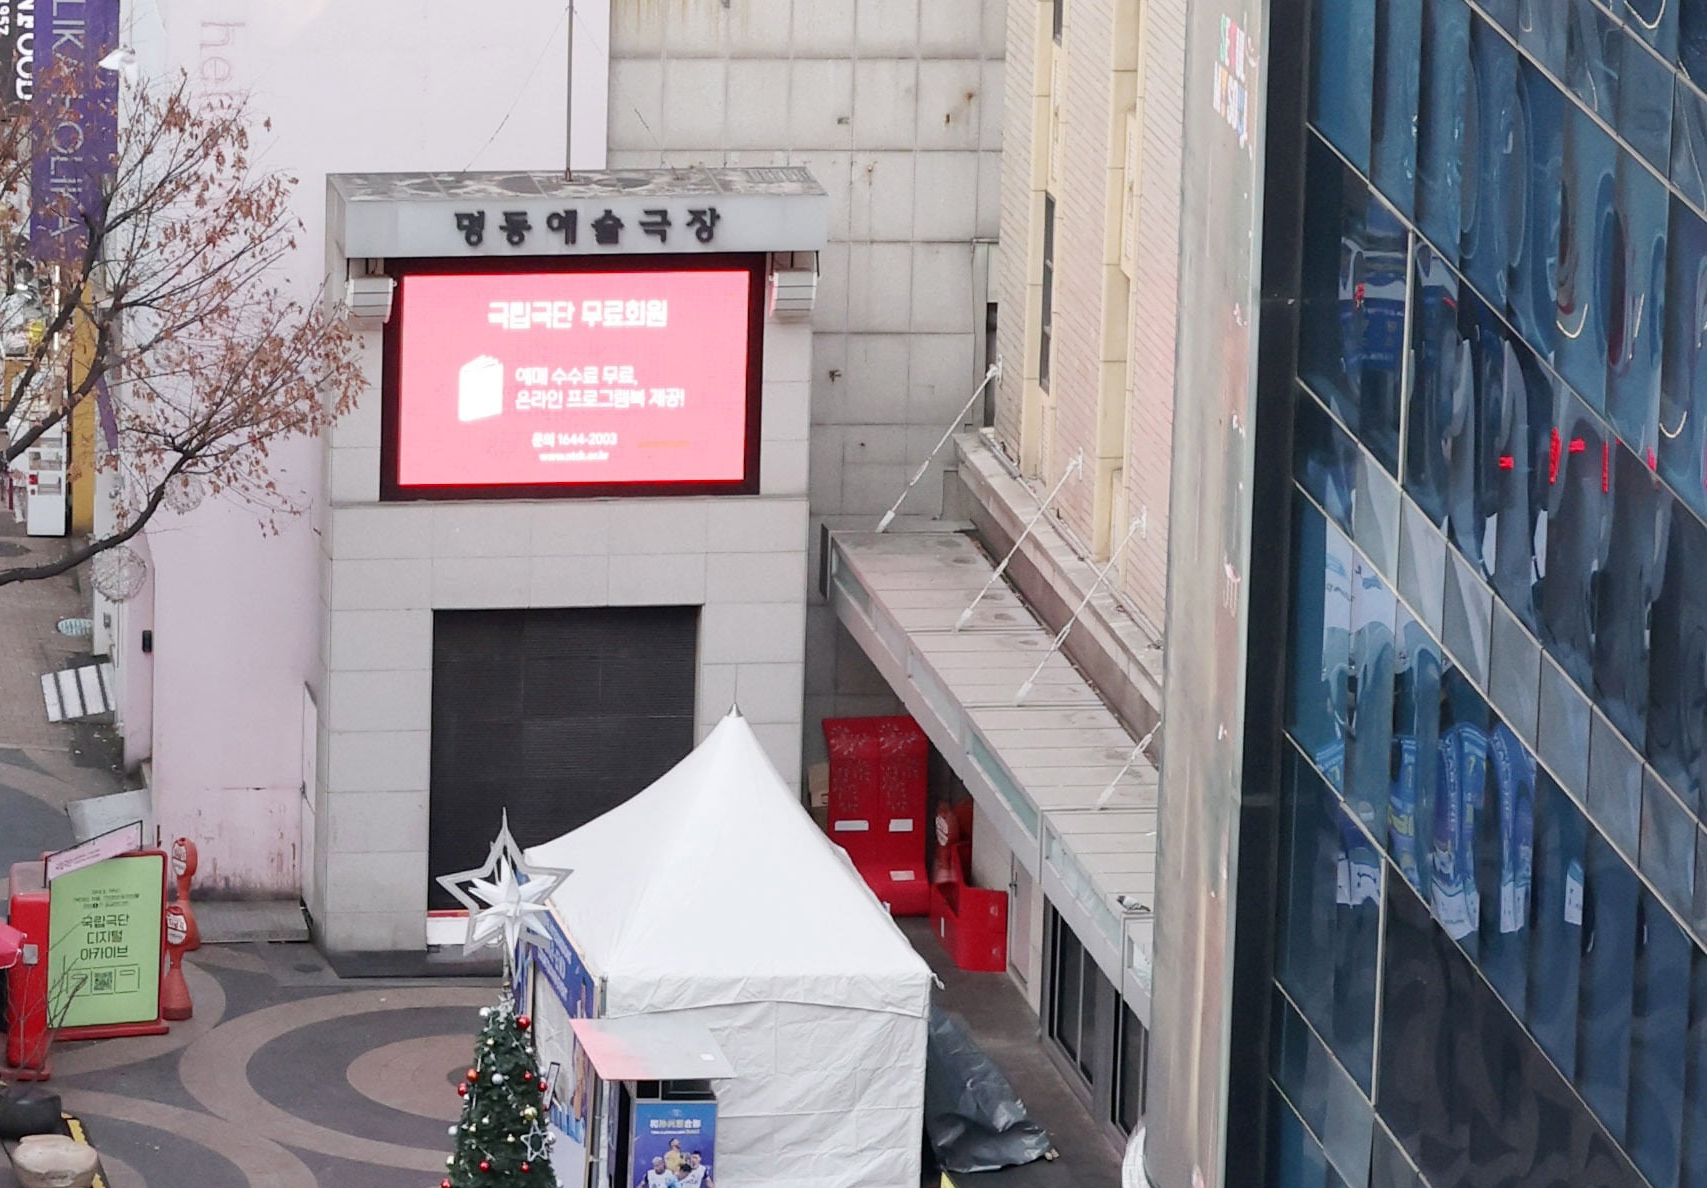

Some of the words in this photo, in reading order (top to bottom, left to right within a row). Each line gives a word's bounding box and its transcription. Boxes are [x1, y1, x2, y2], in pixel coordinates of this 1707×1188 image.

[455, 206, 721, 246] 명동예술극장
[487, 300, 576, 330] 국립극단
[581, 299, 669, 328] 무료회원
[515, 389, 563, 409] 온라인
[557, 432, 618, 446] 1644-2003
